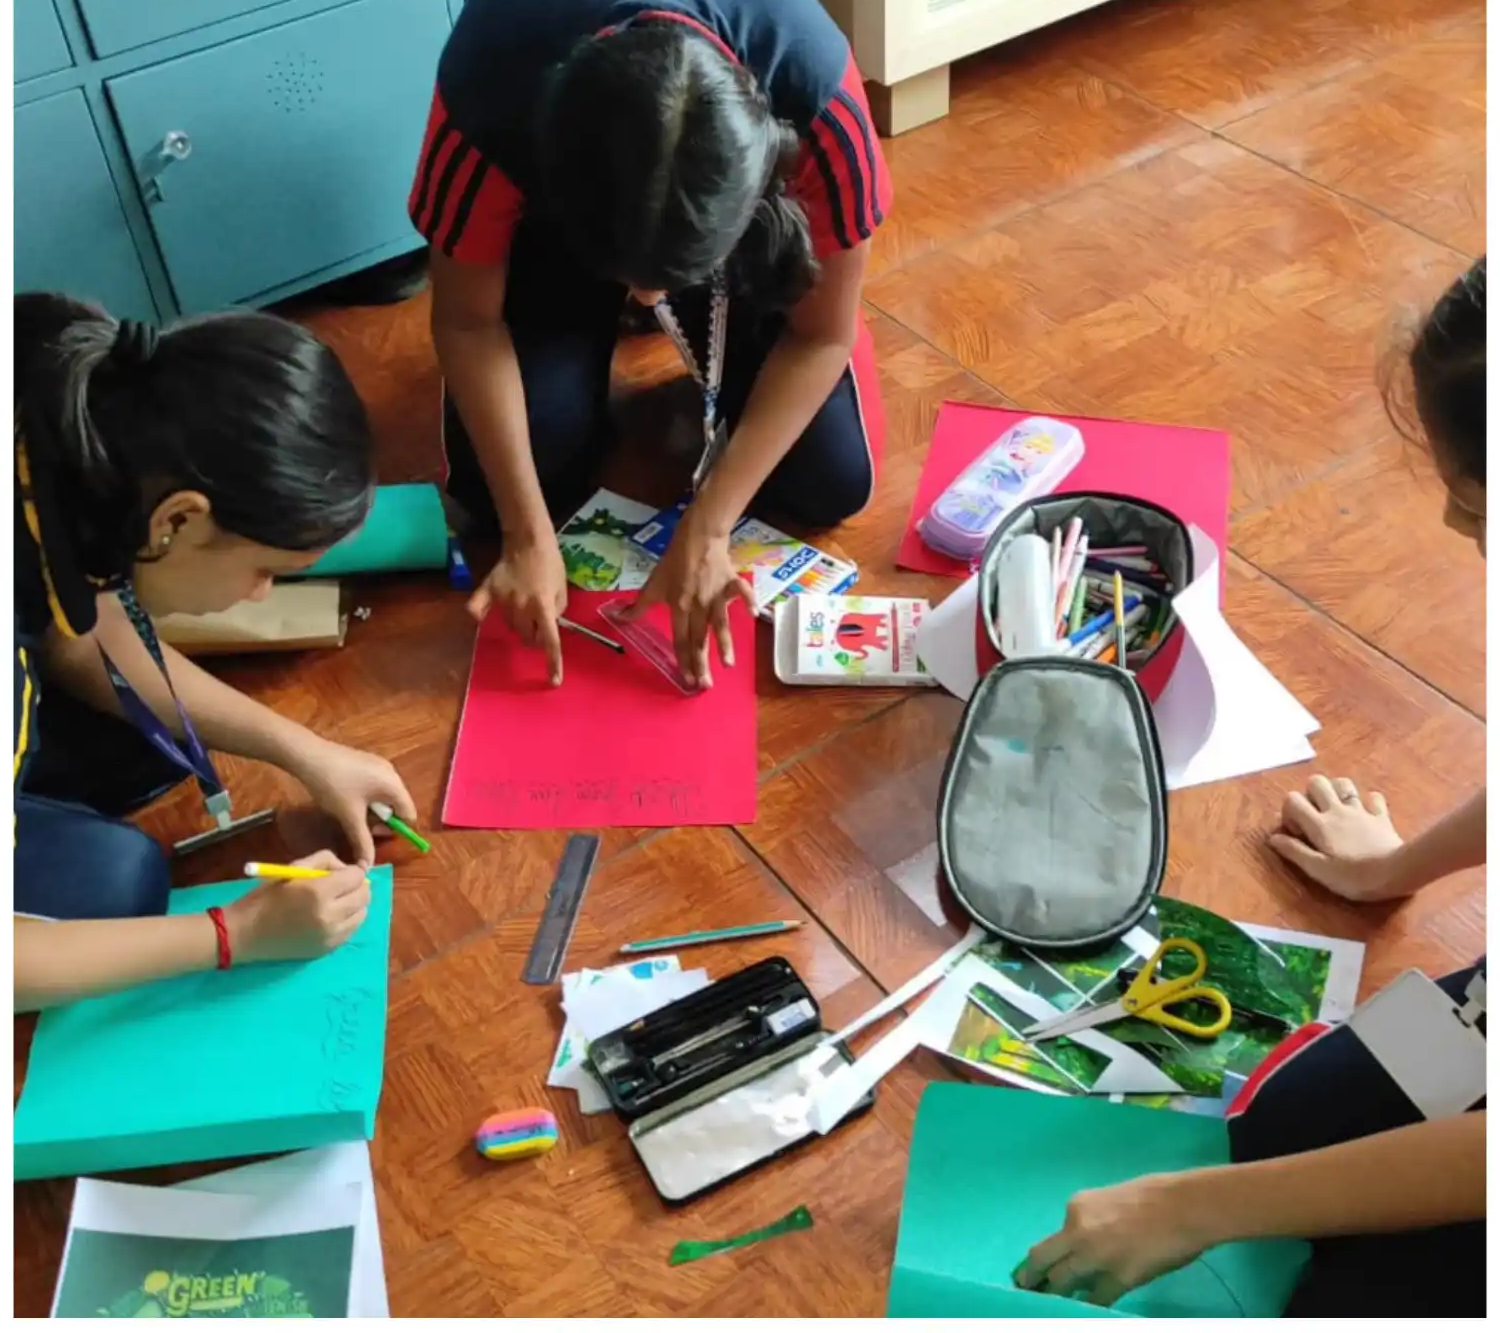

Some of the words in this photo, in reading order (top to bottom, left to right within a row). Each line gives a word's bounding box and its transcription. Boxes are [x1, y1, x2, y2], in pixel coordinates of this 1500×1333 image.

[775, 545, 818, 582] DOMS
[806, 611, 825, 648] tales
[168, 1271, 258, 1318] GREEN
